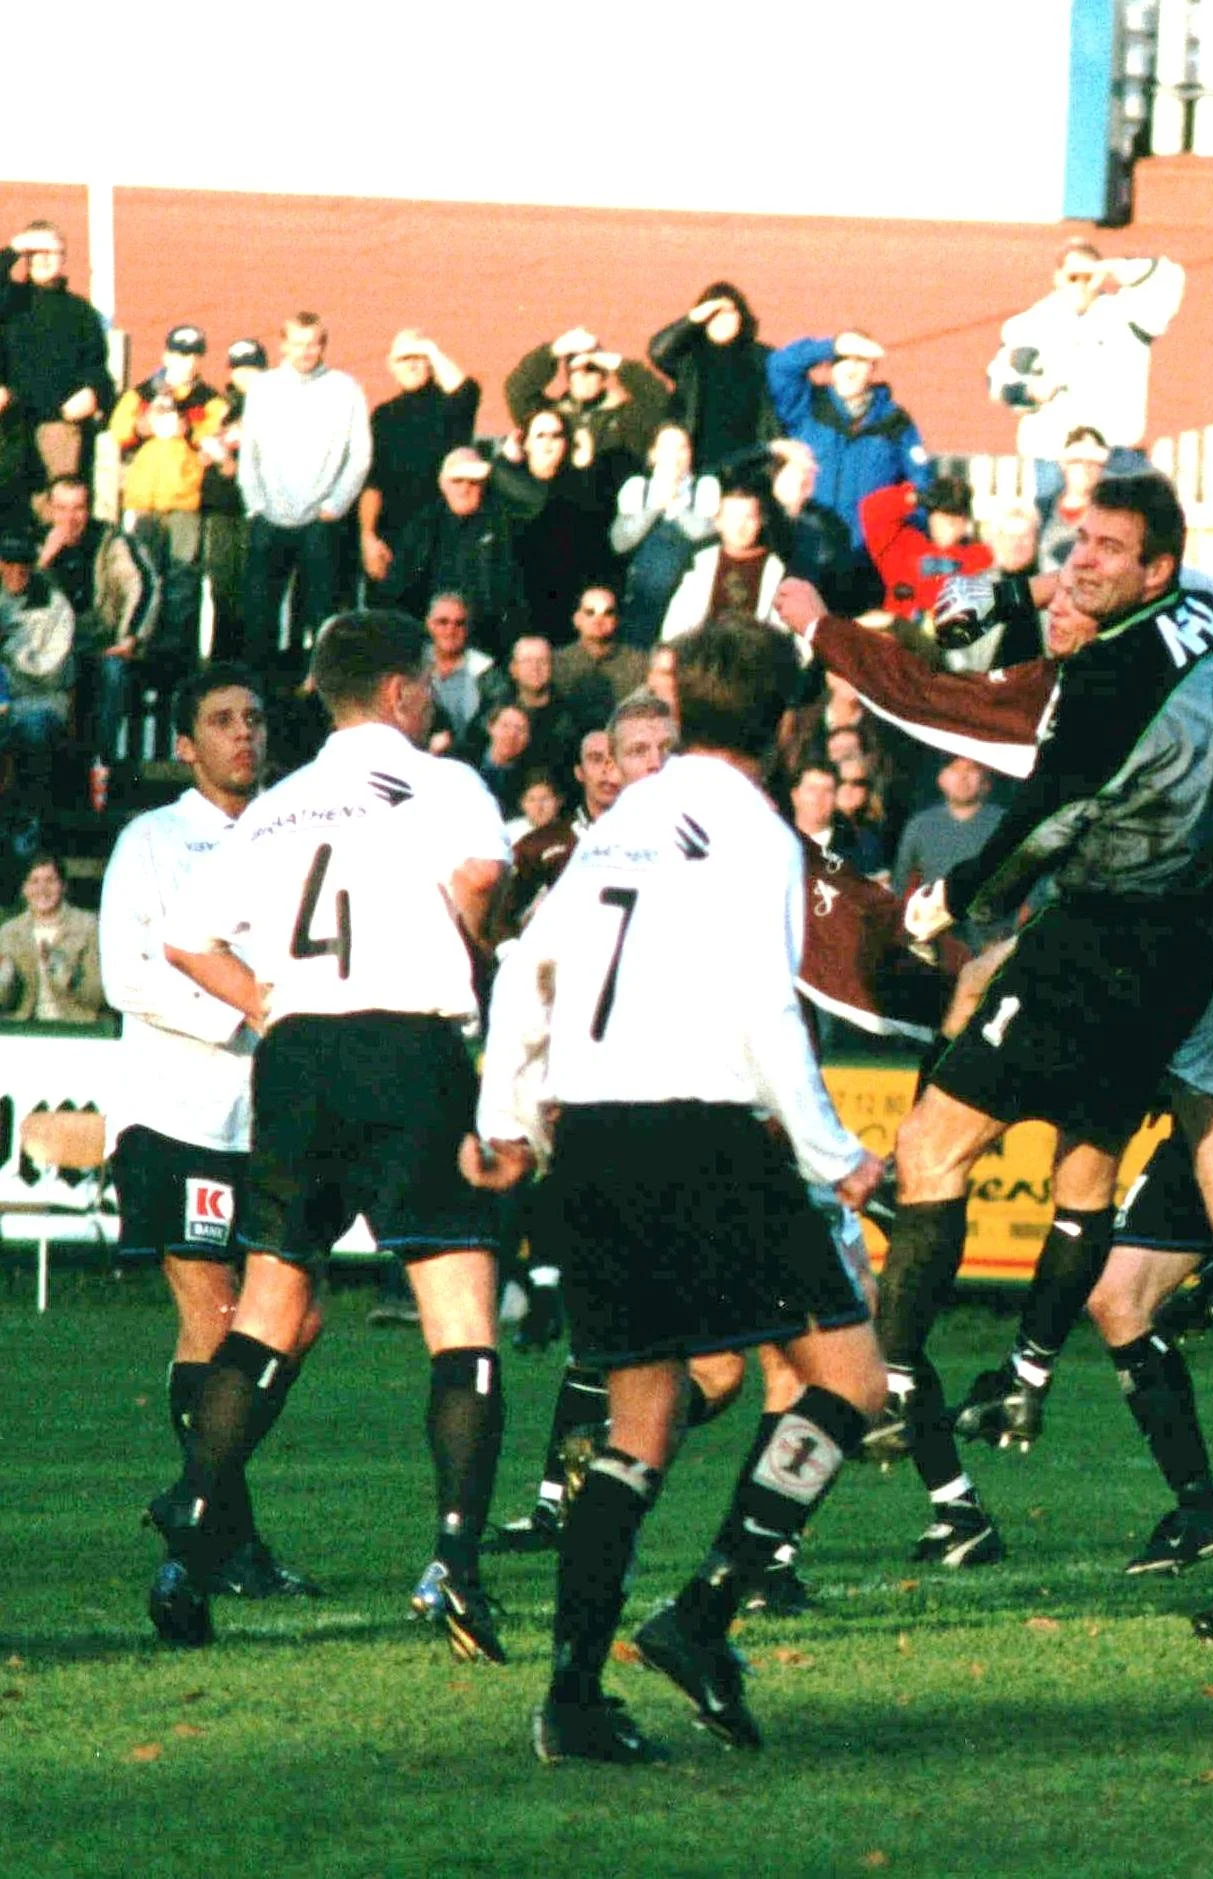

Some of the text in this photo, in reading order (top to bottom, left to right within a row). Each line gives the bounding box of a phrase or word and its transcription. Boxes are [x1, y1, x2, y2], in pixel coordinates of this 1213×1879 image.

[289, 843, 352, 981] 4
[590, 886, 639, 1042] 7
[197, 1187, 226, 1220] K
